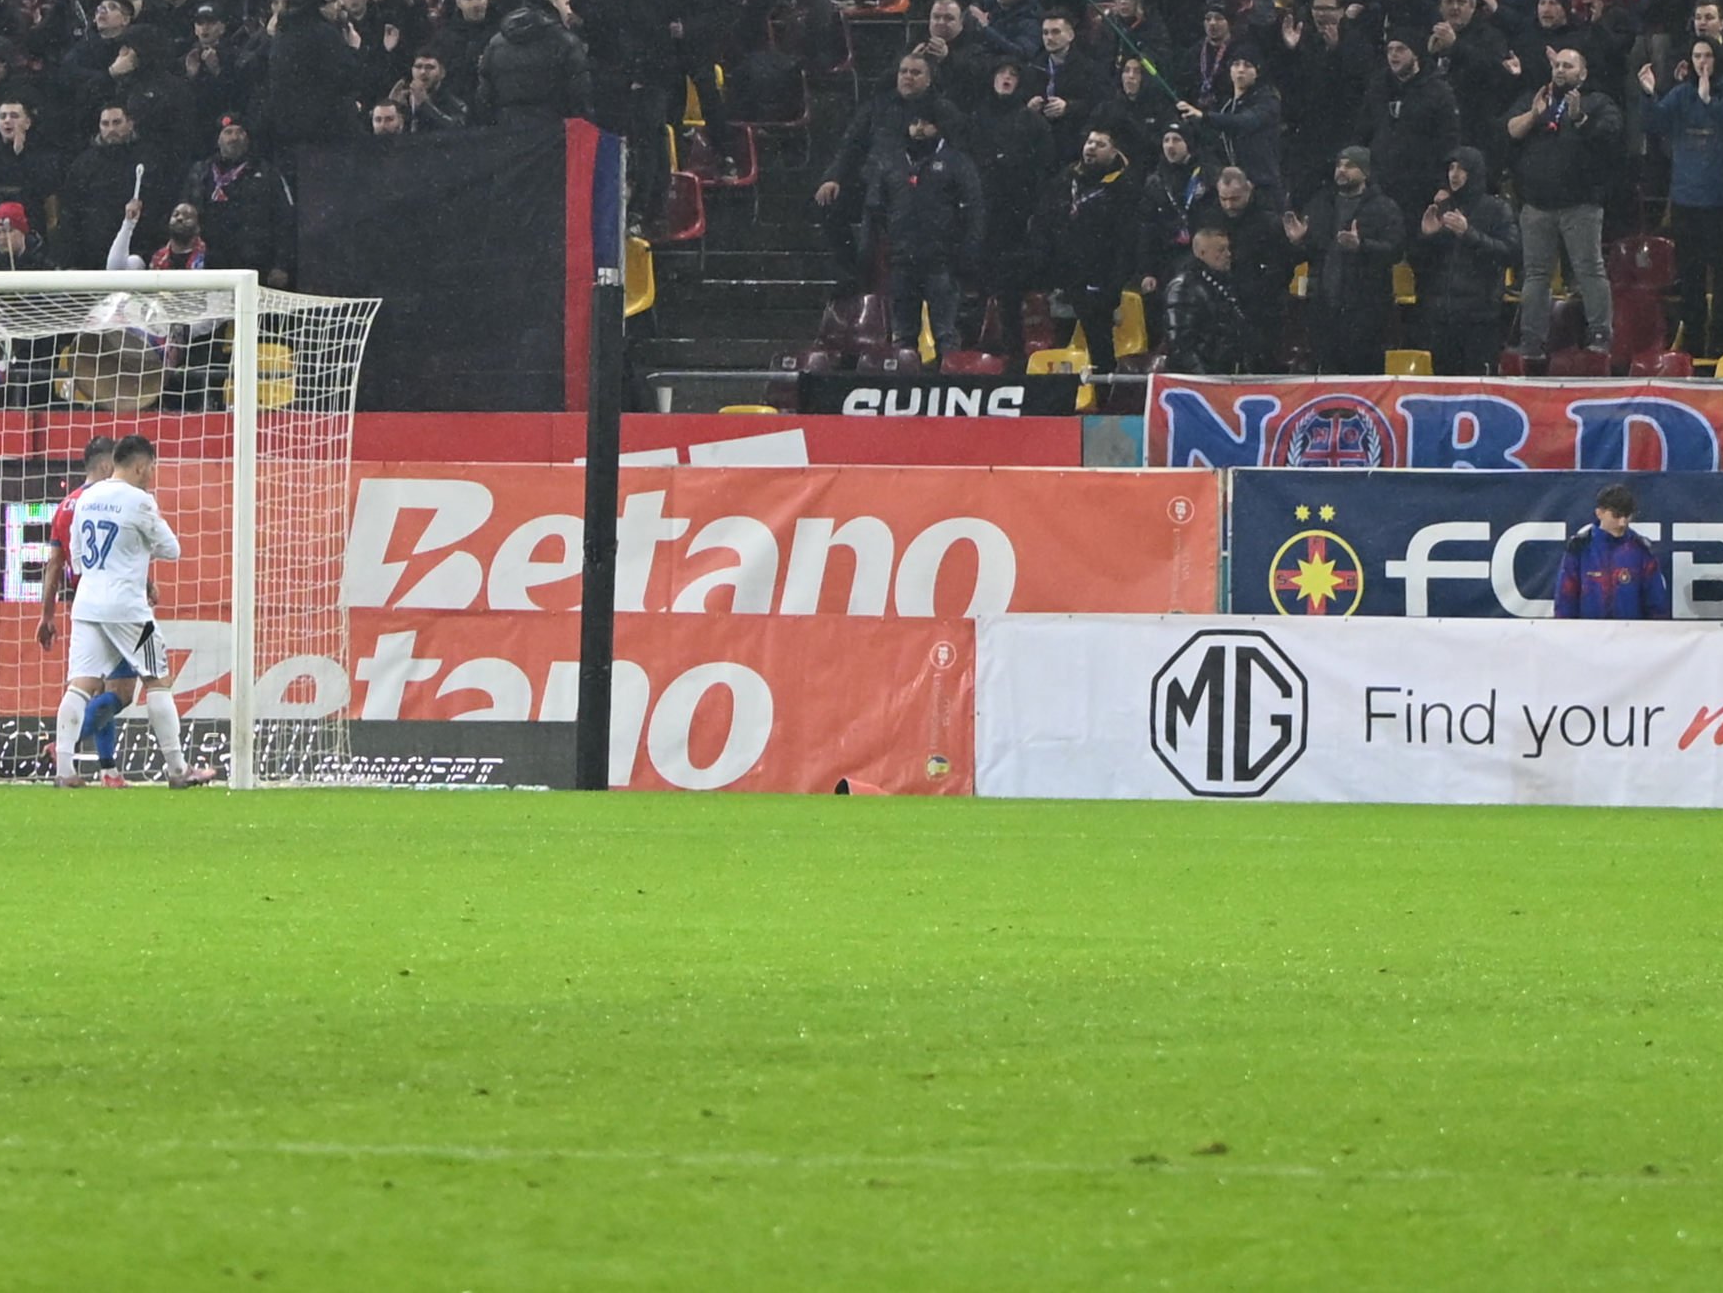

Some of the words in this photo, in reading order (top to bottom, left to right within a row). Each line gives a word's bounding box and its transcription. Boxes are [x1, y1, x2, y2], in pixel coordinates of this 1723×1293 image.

[81, 519, 119, 571] 37
[342, 477, 1017, 619] Betano
[1164, 645, 1294, 782] MG
[1365, 687, 1497, 745] Find
[1522, 705, 1665, 759] your
